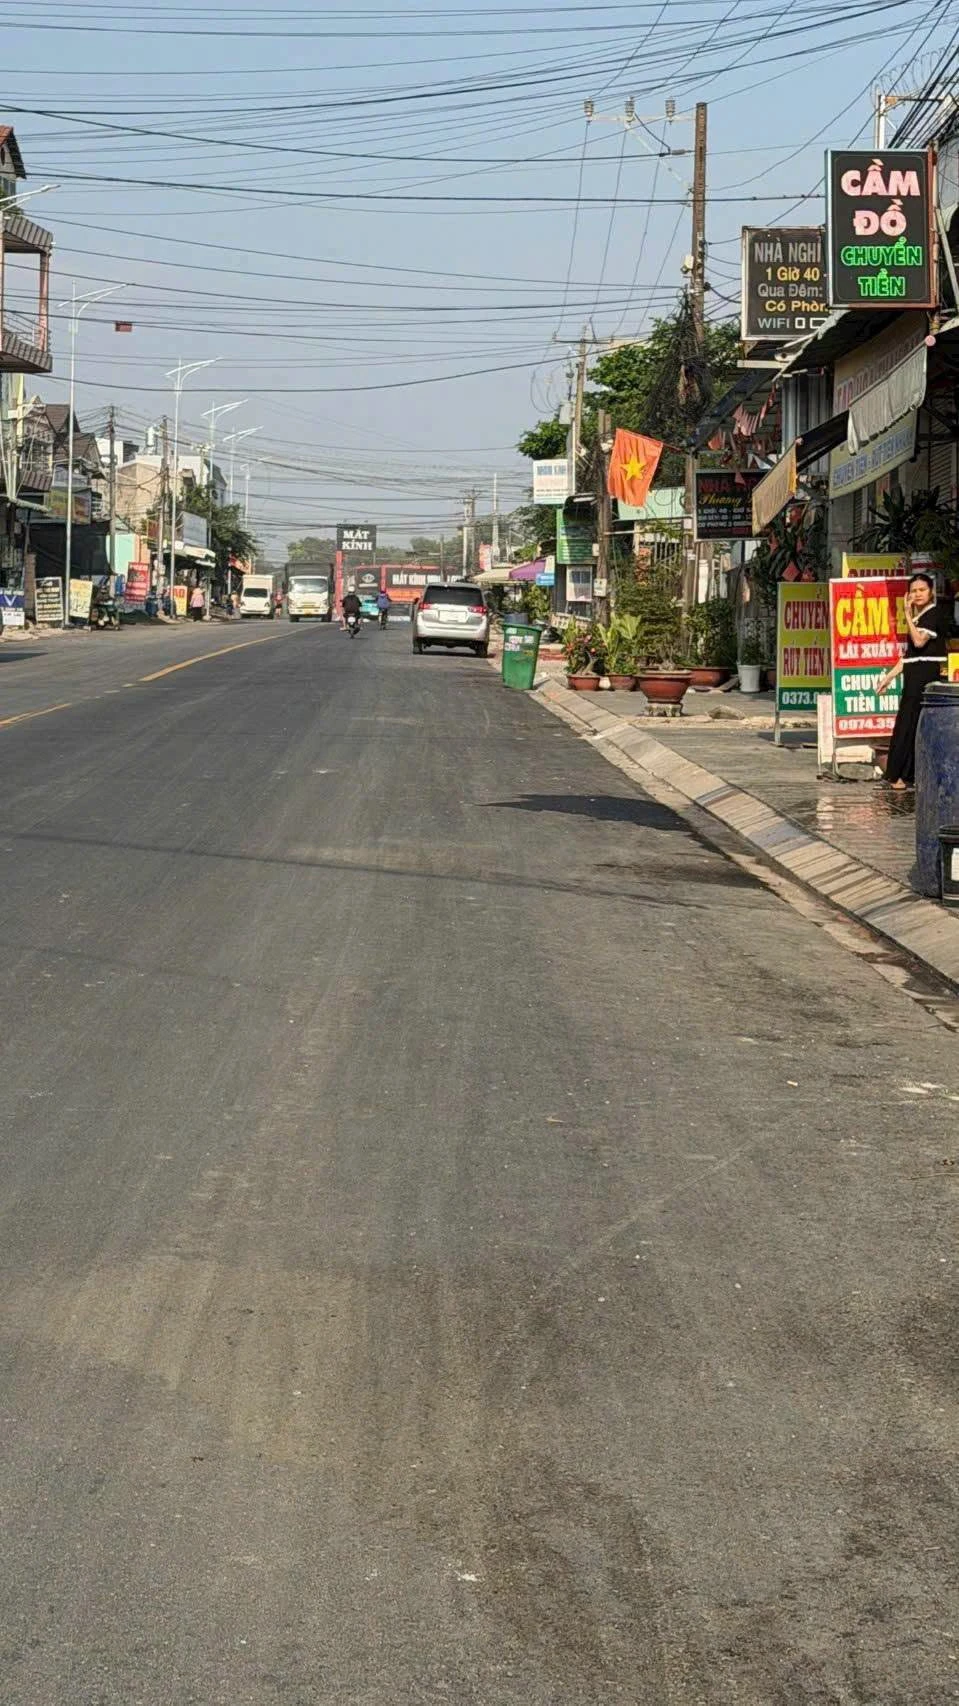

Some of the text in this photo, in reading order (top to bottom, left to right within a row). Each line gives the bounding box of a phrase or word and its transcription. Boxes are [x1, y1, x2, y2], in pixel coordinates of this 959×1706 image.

[841, 159, 921, 197] CẦM
[853, 199, 907, 236] ĐỒ
[754, 237, 783, 263] NHÀ
[841, 236, 922, 266] CHUYỂN
[765, 266, 820, 281] 1 Giờ 40
[757, 283, 785, 297] Qua
[765, 300, 787, 312] Có
[758, 317, 790, 329] WIFI
[836, 583, 889, 637] CẦM
[844, 691, 901, 713] TIỀN NH
[838, 717, 896, 731] 0974.35
